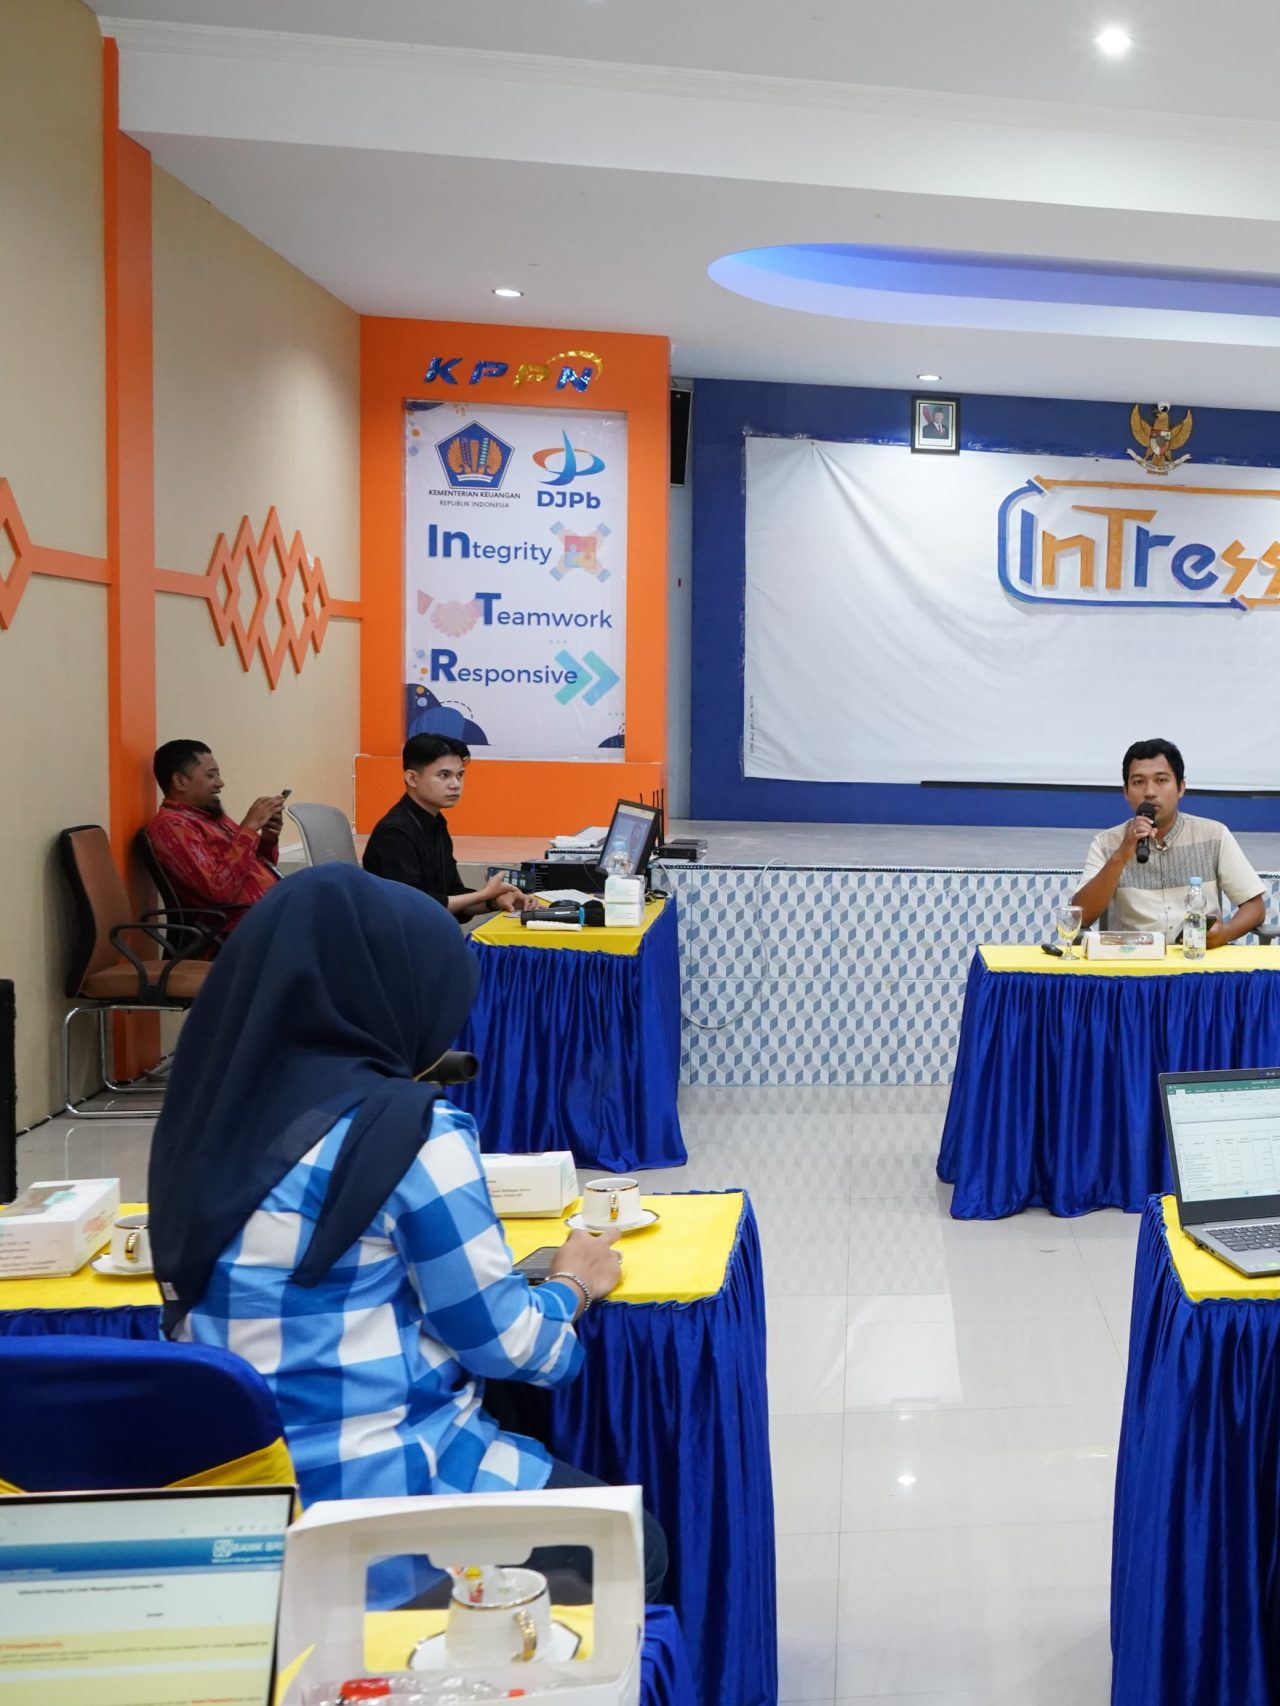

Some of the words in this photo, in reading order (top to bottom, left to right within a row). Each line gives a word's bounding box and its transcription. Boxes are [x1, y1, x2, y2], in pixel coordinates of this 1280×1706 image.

[423, 356, 594, 392] KPPN
[428, 488, 478, 497] KEMENTERIAN
[480, 491, 521, 499] KEUANGAN
[537, 489, 601, 509] DJPb
[428, 523, 552, 566] Integrity
[475, 592, 613, 629] Teamwork
[430, 648, 578, 687] Responsive
